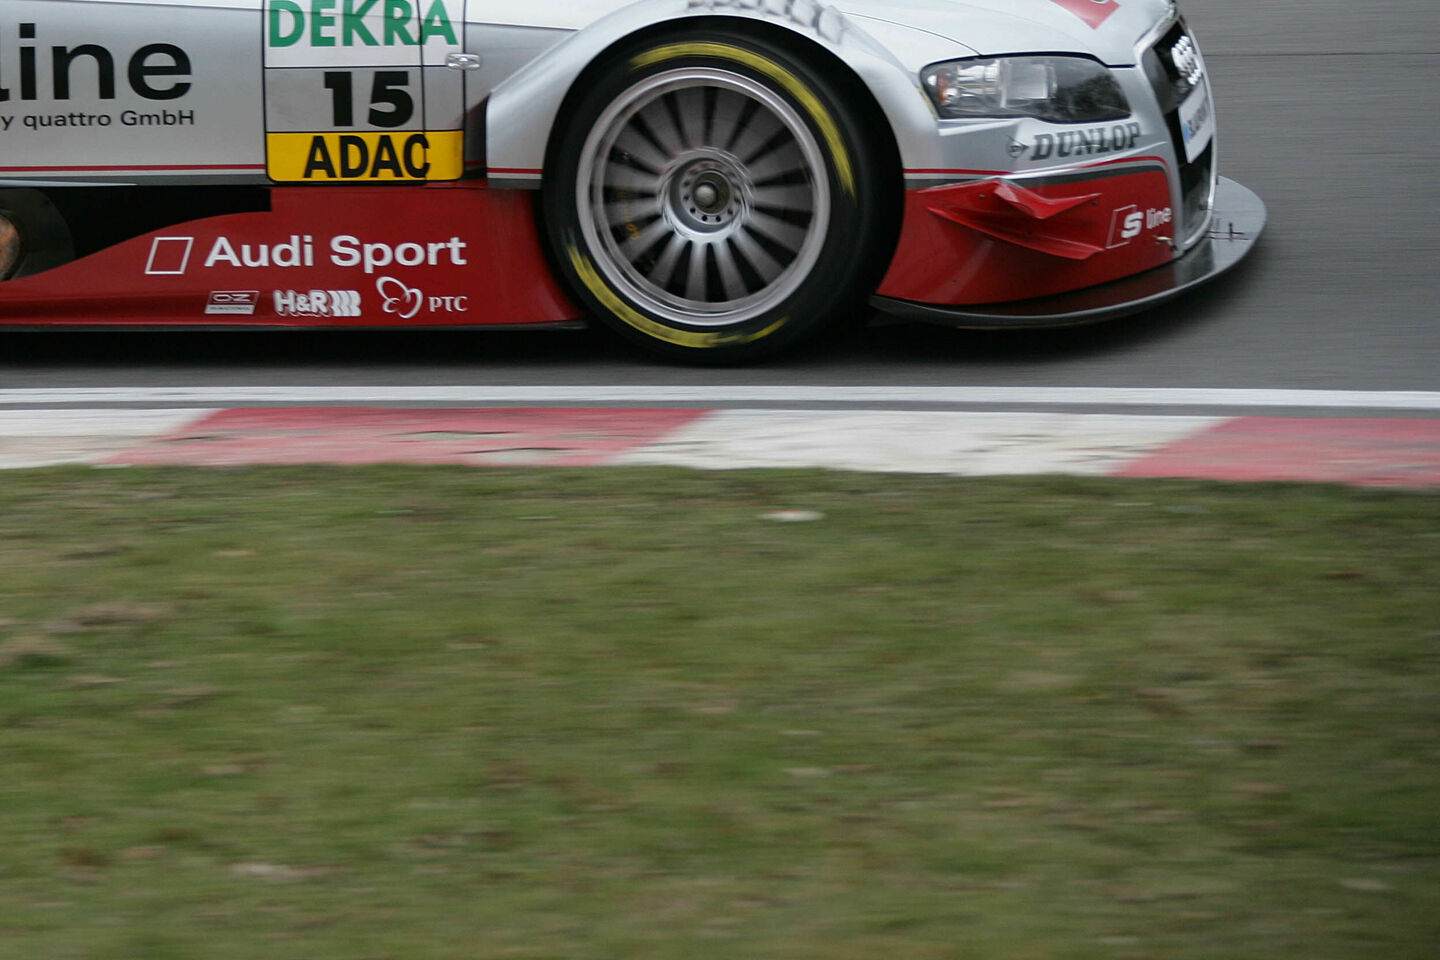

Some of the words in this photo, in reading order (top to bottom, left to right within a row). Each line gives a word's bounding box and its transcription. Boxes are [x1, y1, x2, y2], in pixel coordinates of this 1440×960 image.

[323, 70, 414, 128] 15
[23, 111, 112, 130] quattro
[120, 109, 195, 127] GmbH
[303, 133, 430, 179] ADAC
[1031, 122, 1141, 161] DUNLOP
[204, 235, 314, 268] Audi
[330, 235, 467, 274] Sport
[273, 289, 331, 318] H&R
[428, 295, 468, 313] PTC
